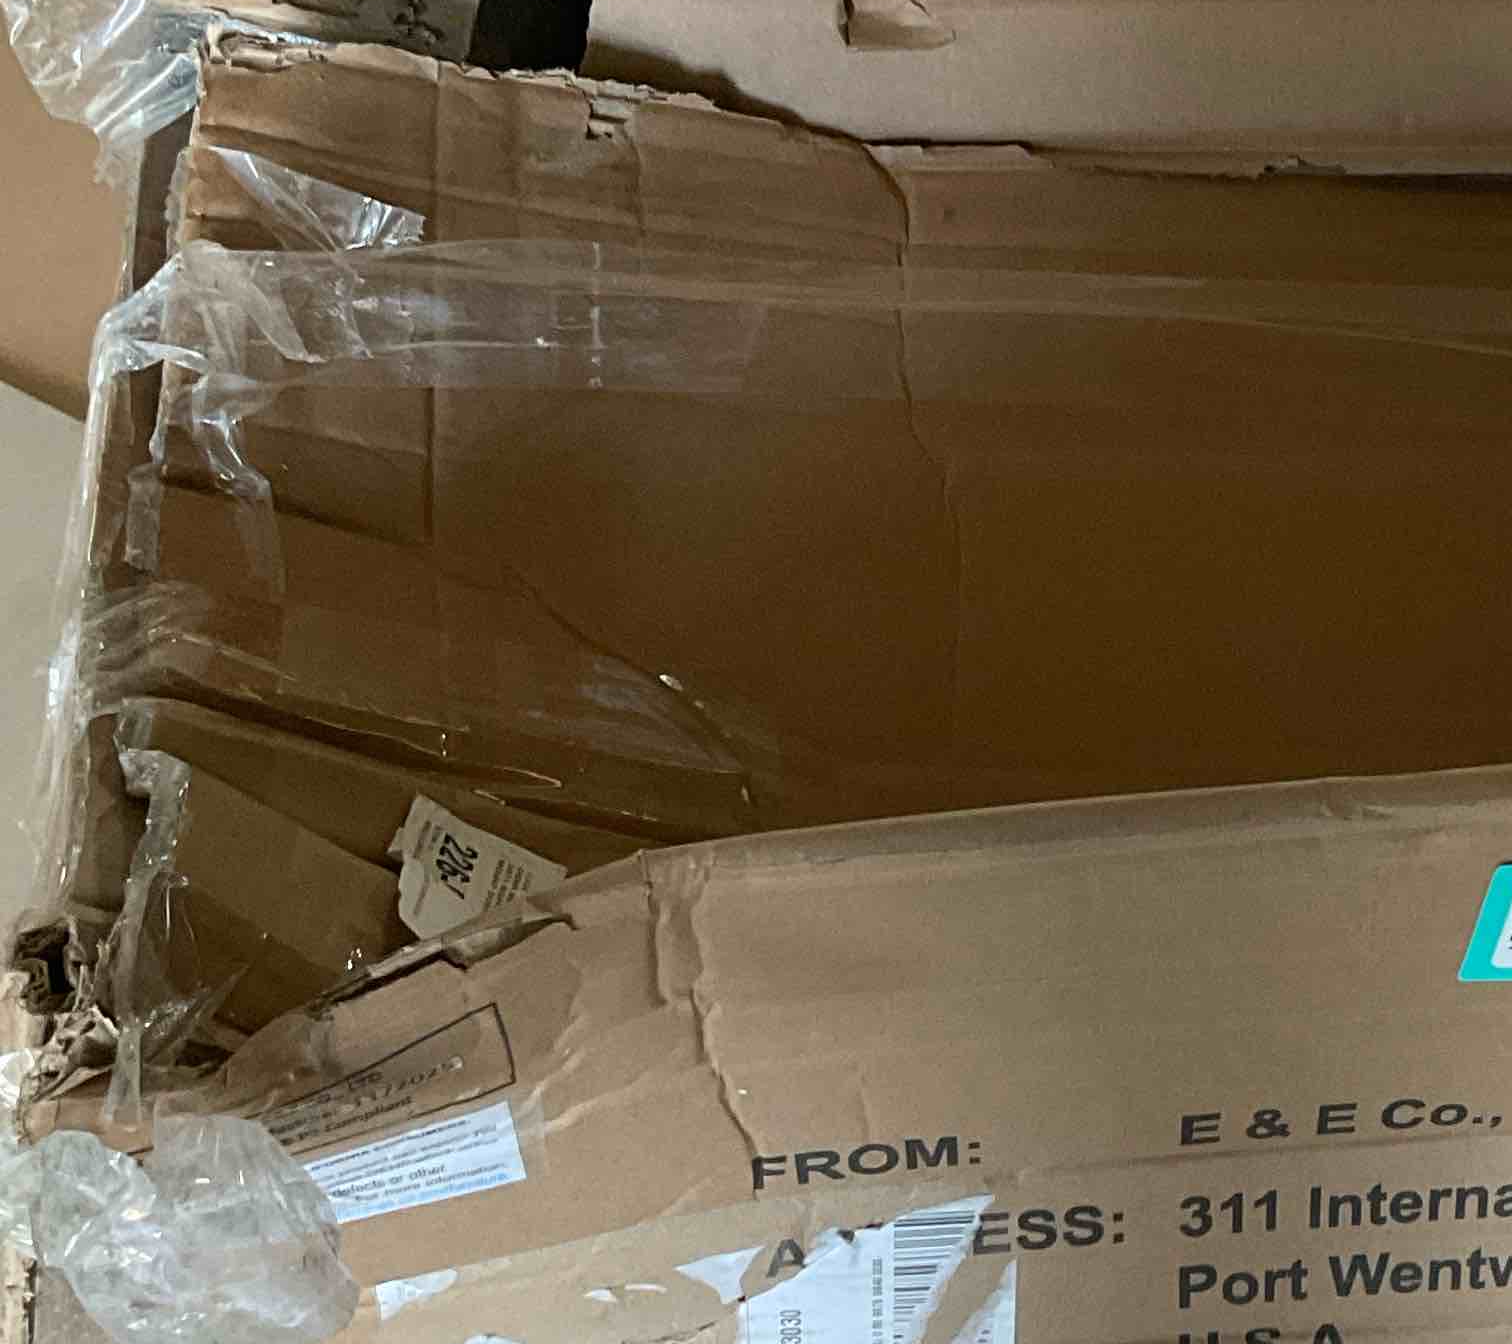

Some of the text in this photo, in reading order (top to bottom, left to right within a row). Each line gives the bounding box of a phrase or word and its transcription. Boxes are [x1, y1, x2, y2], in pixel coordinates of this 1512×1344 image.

[1179, 1112, 1222, 1146] E
[1245, 1108, 1292, 1139] &
[1316, 1102, 1358, 1137] E
[1380, 1098, 1504, 1131] Co.,
[752, 1135, 982, 1190] FROM:
[1179, 1189, 1279, 1238] 311
[1178, 1259, 1309, 1310] Port
